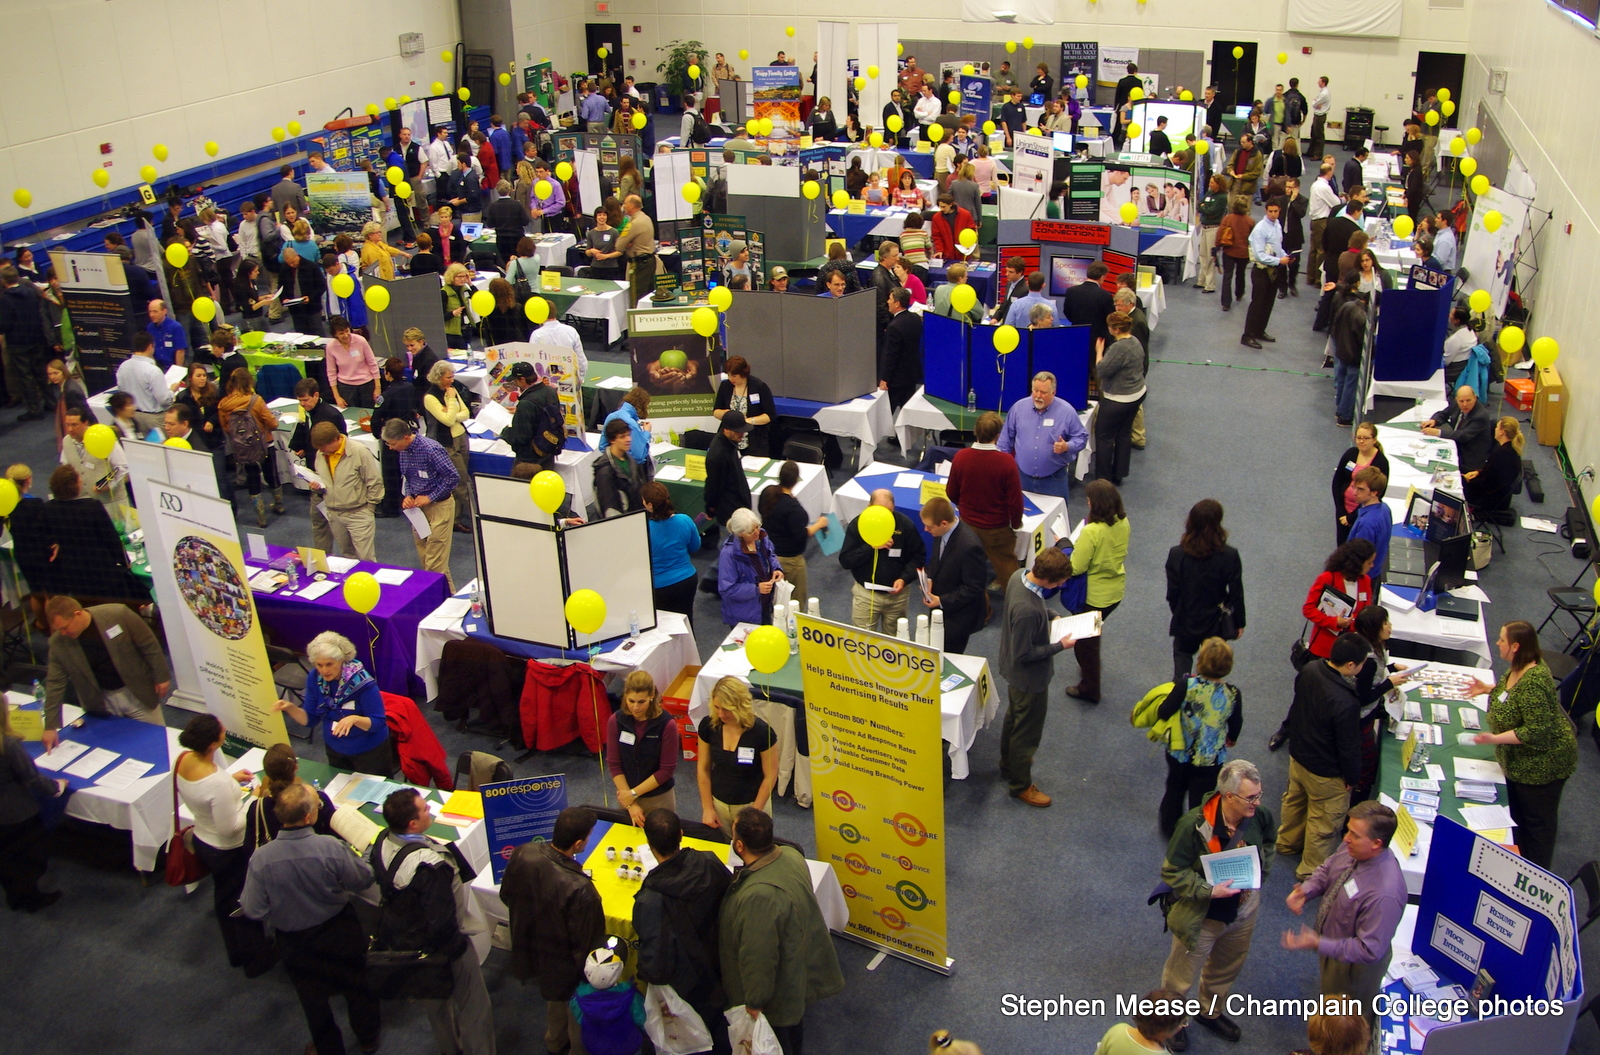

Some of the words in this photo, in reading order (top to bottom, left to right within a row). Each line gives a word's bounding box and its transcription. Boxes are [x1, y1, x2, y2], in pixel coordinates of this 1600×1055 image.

[144, 190, 153, 200] G
[310, 182, 346, 192] SUMMER
[1035, 228, 1094, 237] CONNECTION
[1057, 223, 1108, 232] TECHNICAL
[1035, 532, 1042, 553] B
[802, 626, 935, 673] 800response
[200, 666, 224, 679] Difference
[206, 661, 224, 672] Making
[211, 678, 234, 690] Complex
[806, 663, 824, 676] Help
[827, 669, 873, 688] Businesses
[876, 682, 908, 699] Improve
[911, 693, 934, 705] Their
[981, 674, 987, 698] B
[830, 682, 877, 702] Advertising
[879, 695, 909, 711] Results
[809, 702, 821, 712] Our
[823, 707, 850, 721] Custom
[870, 720, 905, 738] Numbers:
[832, 724, 856, 736] Improve
[868, 734, 897, 749] Response
[898, 744, 916, 755] Rates
[833, 737, 855, 749] Provide
[857, 745, 892, 760] Advertisers
[894, 756, 907, 766] with
[833, 745, 860, 758] Valuable
[861, 754, 890, 767] Customer
[892, 763, 905, 773] Data
[834, 758, 850, 768] Build
[852, 762, 873, 776] Lasting
[875, 770, 903, 786] Branding
[904, 781, 925, 792] Power
[485, 780, 561, 798] 800response
[1486, 917, 1514, 939] REVIEW
[1489, 906, 1516, 928] RESUME
[1445, 927, 1465, 946] MOCK
[1442, 938, 1477, 965] INTERVIEW
